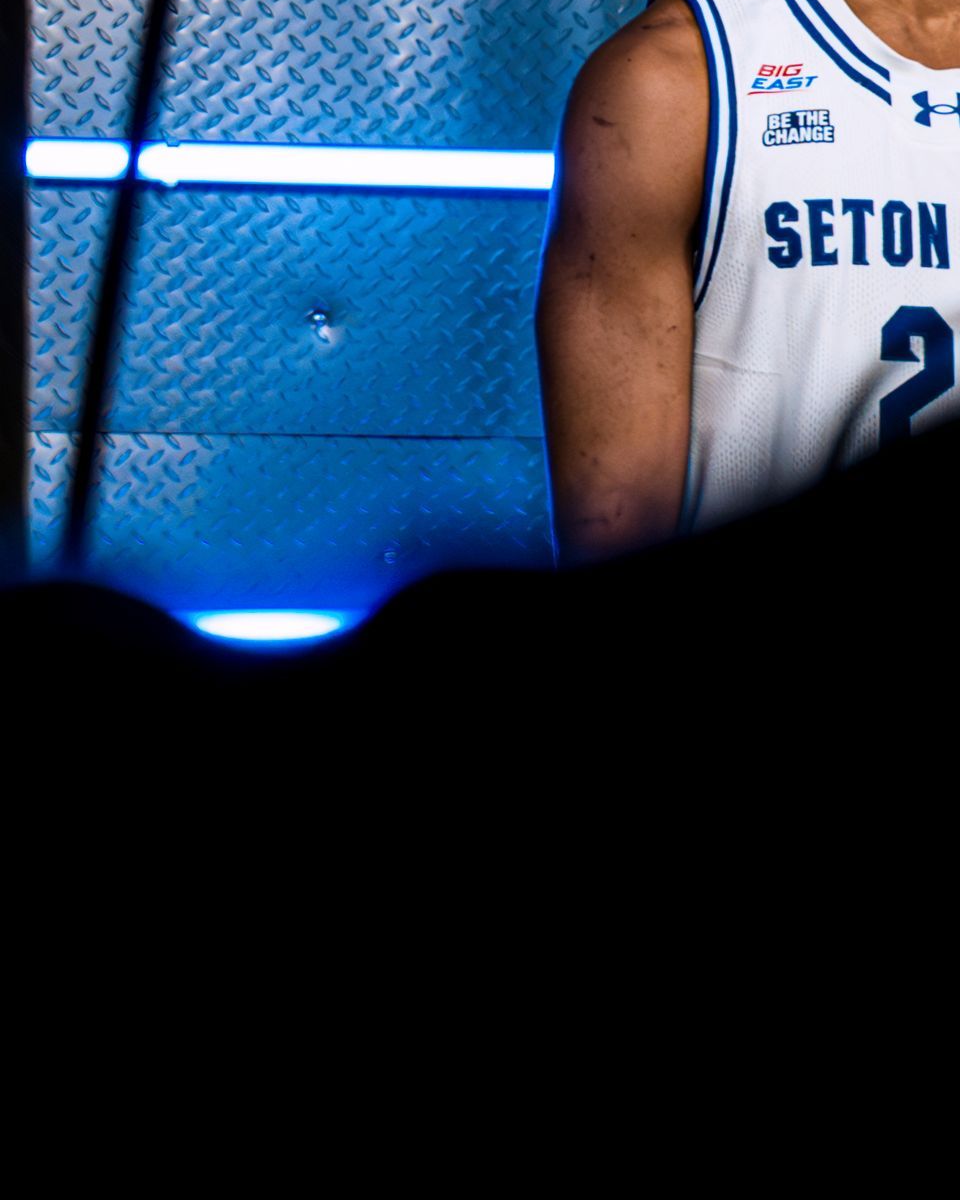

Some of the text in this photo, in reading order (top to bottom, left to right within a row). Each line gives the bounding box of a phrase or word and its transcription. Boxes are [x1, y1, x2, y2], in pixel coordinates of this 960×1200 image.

[757, 63, 804, 77] BIG
[751, 75, 818, 90] EAST
[768, 110, 829, 129] BE THE
[763, 126, 834, 145] CHANGE
[764, 198, 950, 269] SETON
